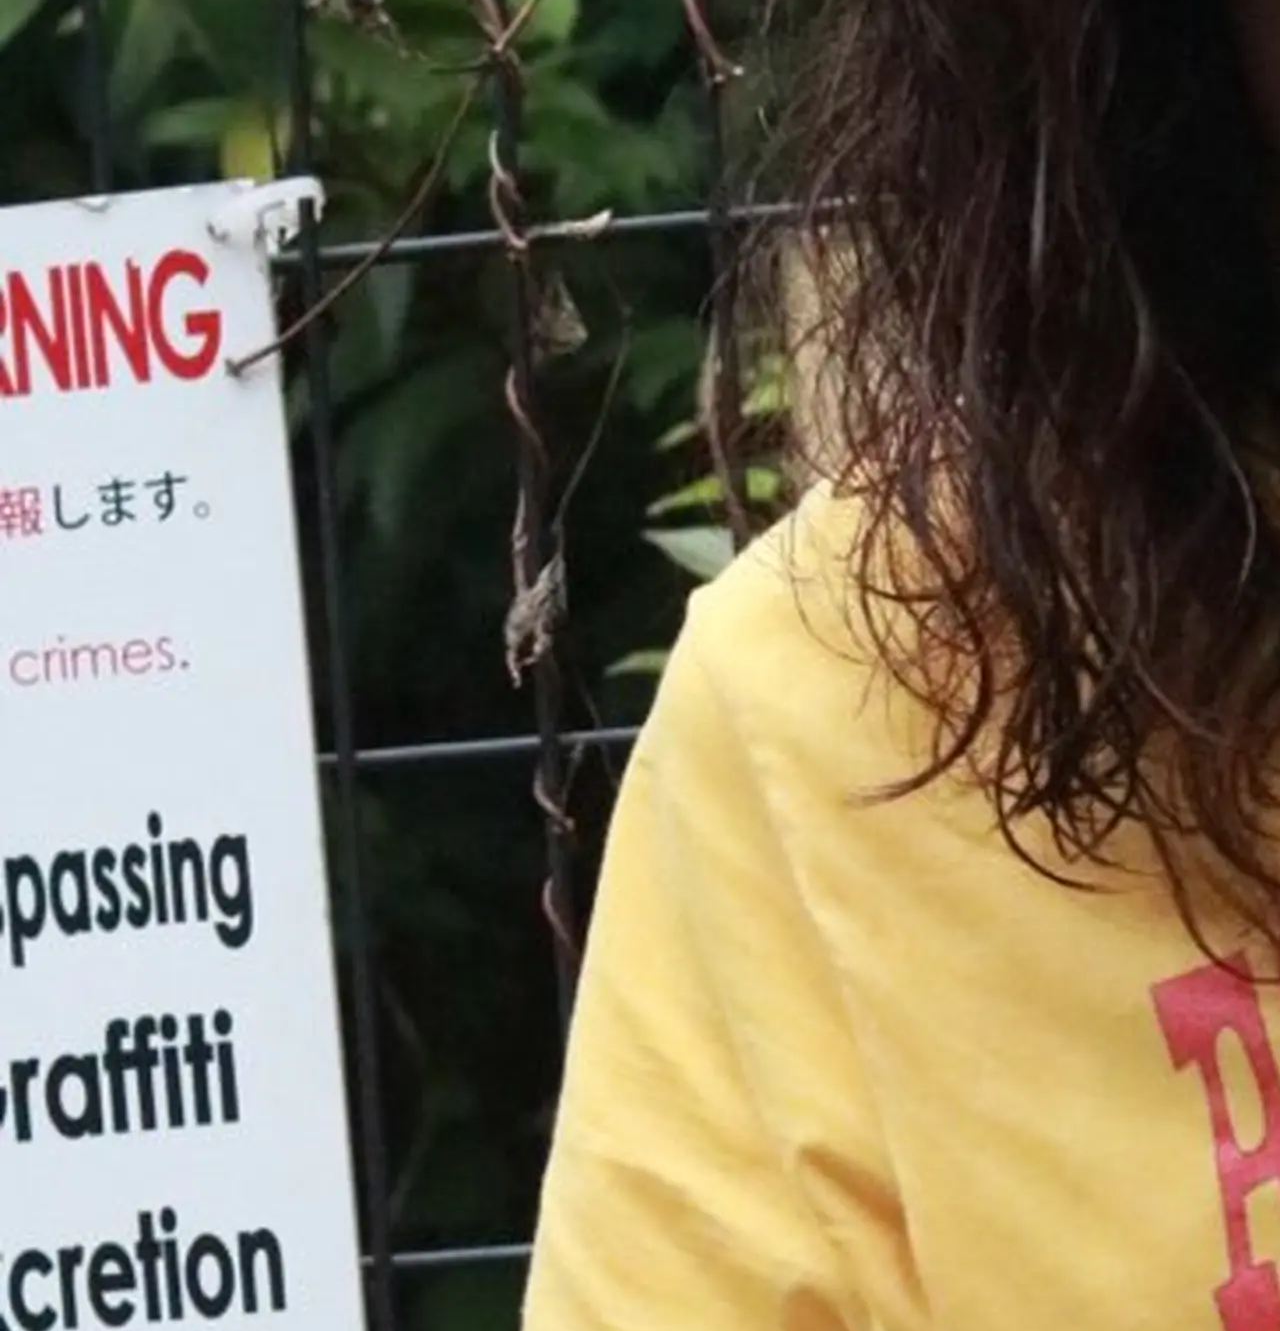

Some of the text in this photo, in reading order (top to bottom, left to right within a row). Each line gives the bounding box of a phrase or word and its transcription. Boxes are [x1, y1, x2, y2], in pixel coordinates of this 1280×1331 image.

[0, 248, 221, 397] NING
[0, 470, 211, 539] 報します。
[9, 634, 190, 686] crimes.
[0, 810, 253, 967] passing
[0, 1008, 240, 1143] raffiti
